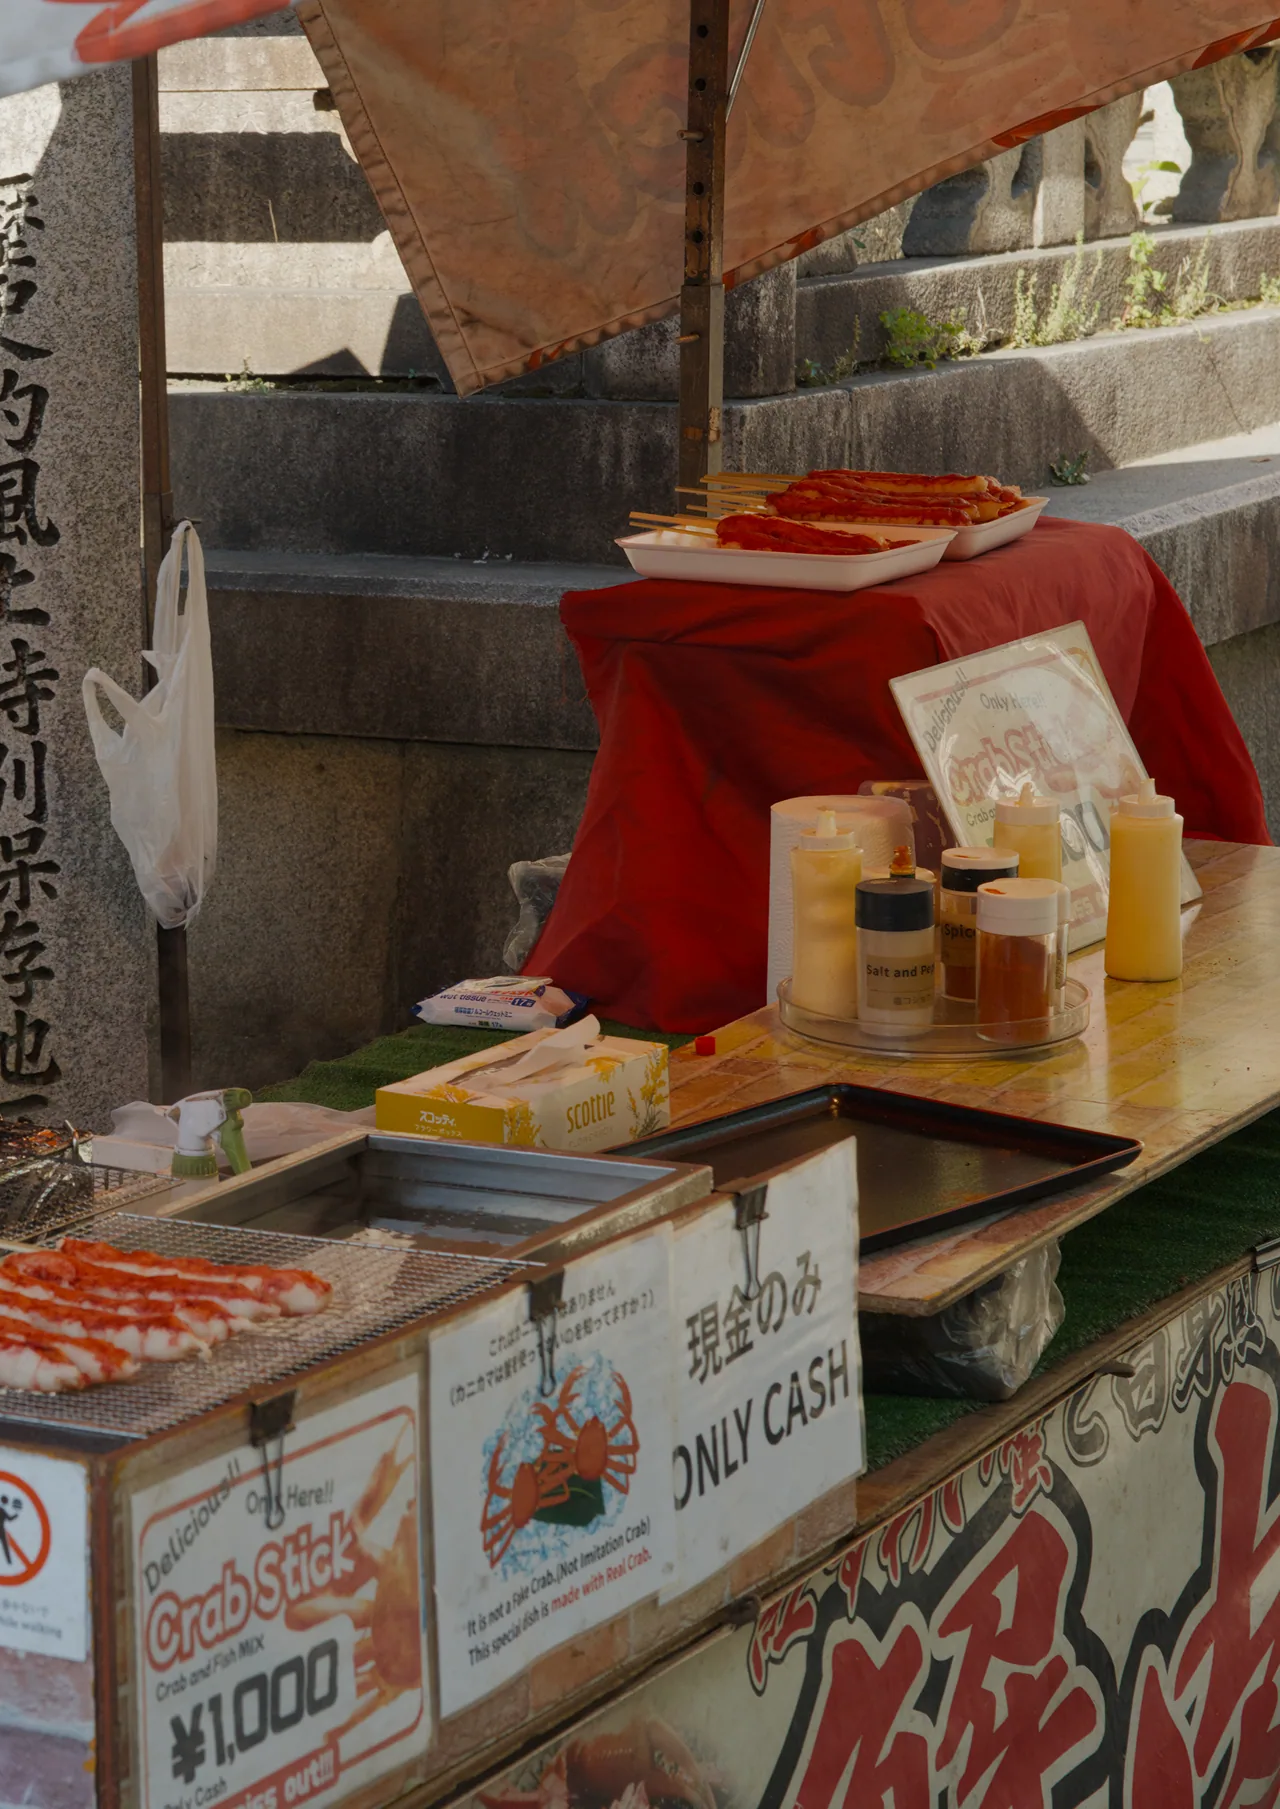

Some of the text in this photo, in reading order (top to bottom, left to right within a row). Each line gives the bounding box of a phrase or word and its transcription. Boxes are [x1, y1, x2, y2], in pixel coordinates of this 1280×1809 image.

[980, 693, 1009, 712] Only
[966, 811, 988, 827] Crab
[866, 964, 890, 978] Salt
[894, 966, 917, 978] and
[419, 1110, 455, 1126] スコッティ
[686, 1249, 823, 1386] 現金のみ
[763, 1339, 850, 1446] CASH
[286, 1480, 335, 1516] Here!!
[144, 1457, 242, 1594] Delicious!!
[147, 1509, 359, 1673] Crab Stick
[551, 1585, 580, 1614] made
[582, 1571, 605, 1596] with
[606, 1557, 626, 1583] Real
[155, 1672, 189, 1703] Crab
[189, 1657, 212, 1689] and
[170, 1637, 339, 1786] ¥1,000
